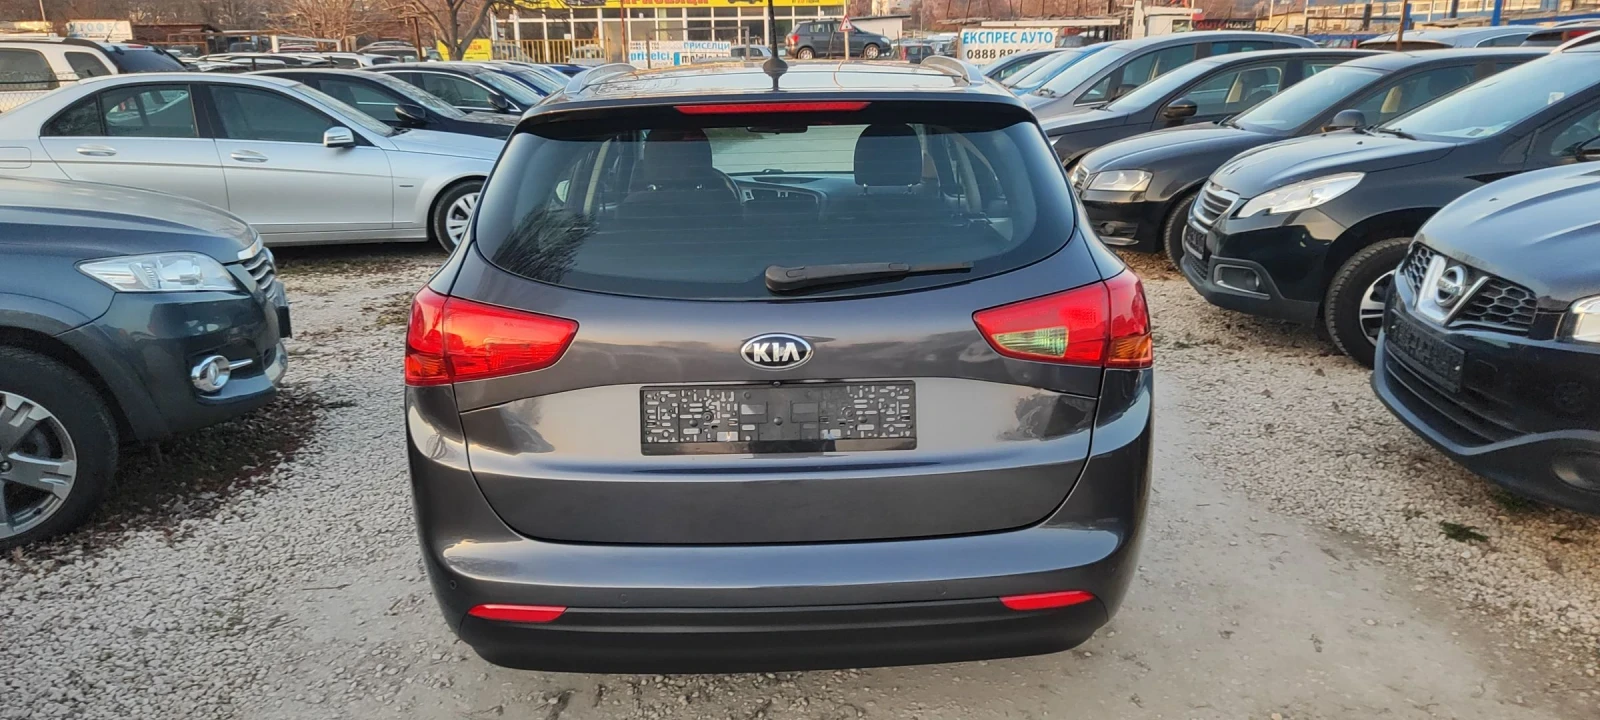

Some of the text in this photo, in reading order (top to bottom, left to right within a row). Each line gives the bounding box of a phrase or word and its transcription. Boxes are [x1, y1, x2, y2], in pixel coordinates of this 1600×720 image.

[963, 32, 1053, 44] ЕКСПРЕС АУТО
[683, 42, 730, 51] ПРИСЕЛЦИ
[966, 49, 996, 59] 0888
[752, 342, 801, 362] KIA
